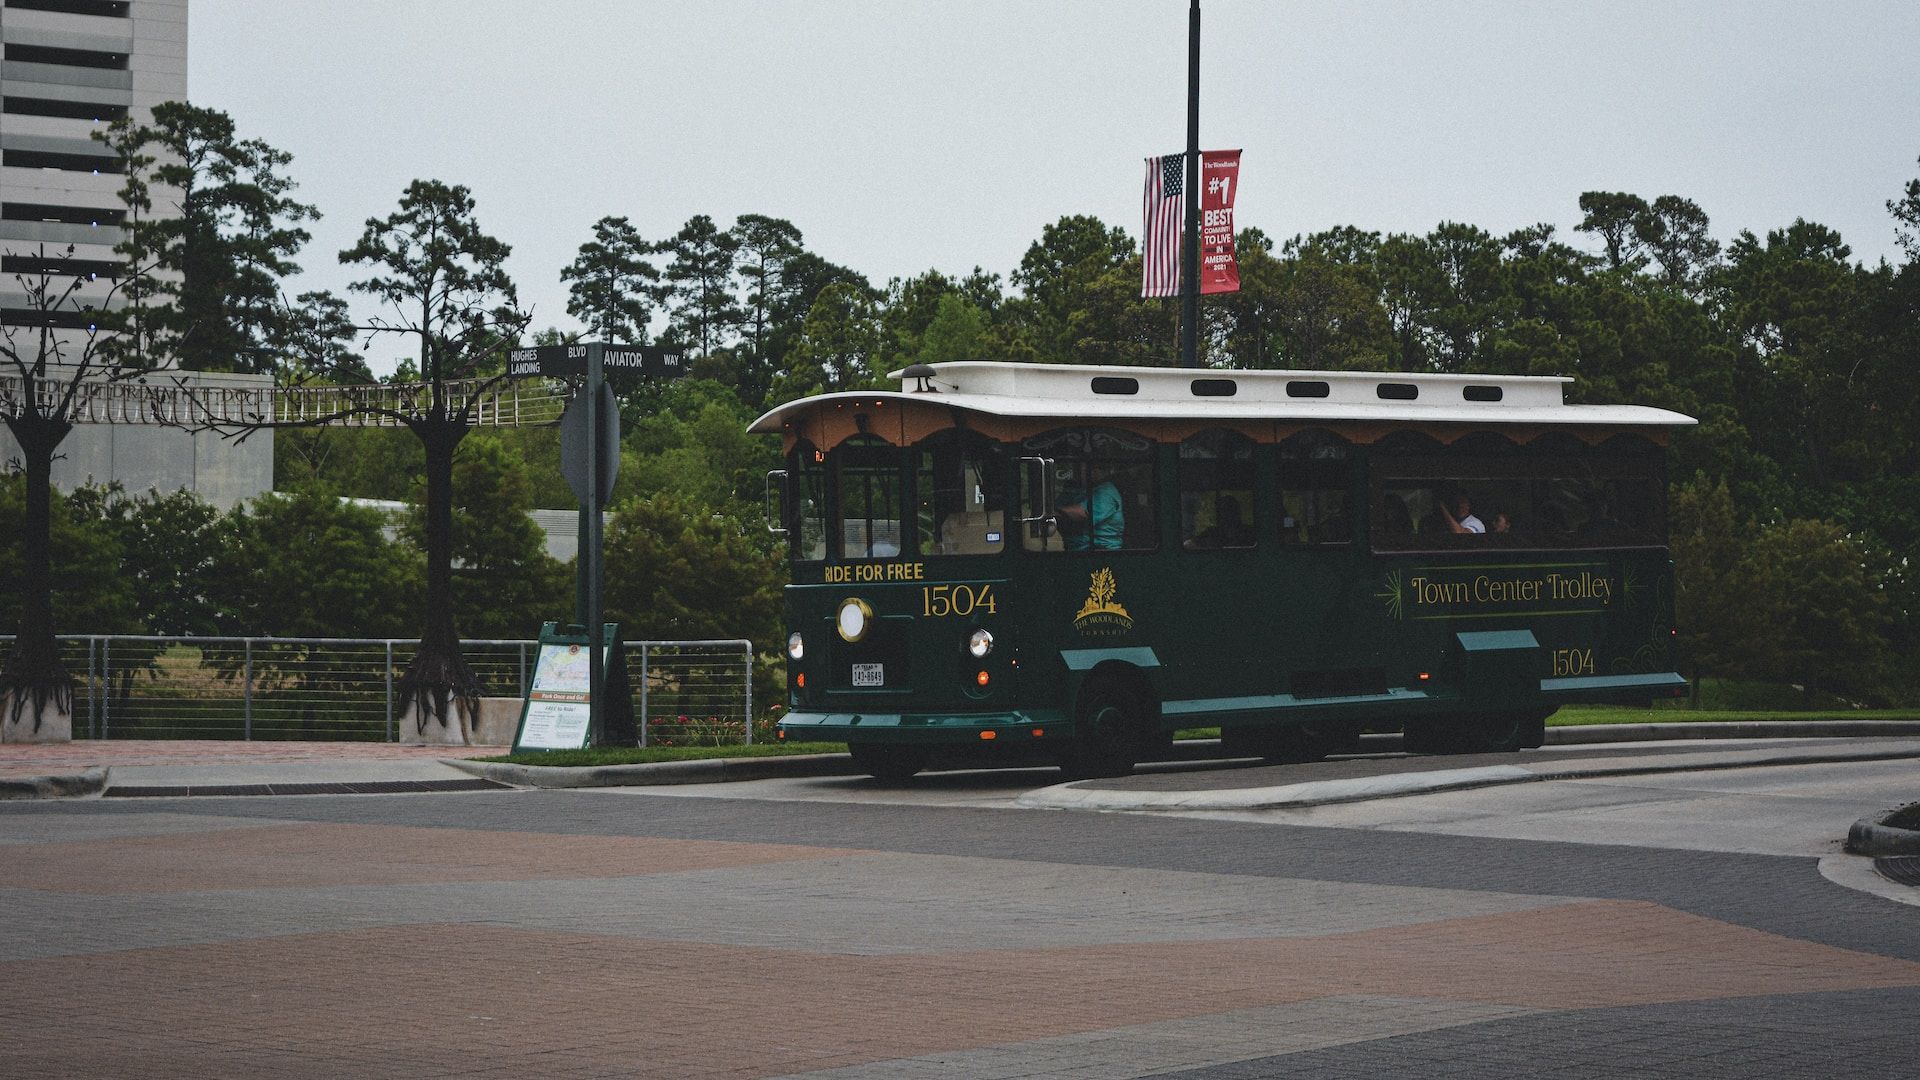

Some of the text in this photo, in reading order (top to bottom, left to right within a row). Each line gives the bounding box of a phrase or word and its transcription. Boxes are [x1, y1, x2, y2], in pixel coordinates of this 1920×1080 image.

[1208, 176, 1231, 205] #1
[1204, 208, 1232, 226] BEST
[1204, 234, 1231, 245] TO LIVE
[1204, 254, 1233, 264] AMERICA
[511, 349, 538, 362] HUGHES
[568, 346, 587, 358] BLVD
[604, 350, 680, 368] AVIATOR WAY
[511, 362, 541, 375] LANDING
[825, 563, 924, 583] RIDE FOR FREE
[1411, 572, 1615, 605] Town Center Trolley
[922, 584, 997, 617] 1504
[1075, 614, 1133, 631] THE WOODLANDS
[1553, 649, 1595, 676] 1504
